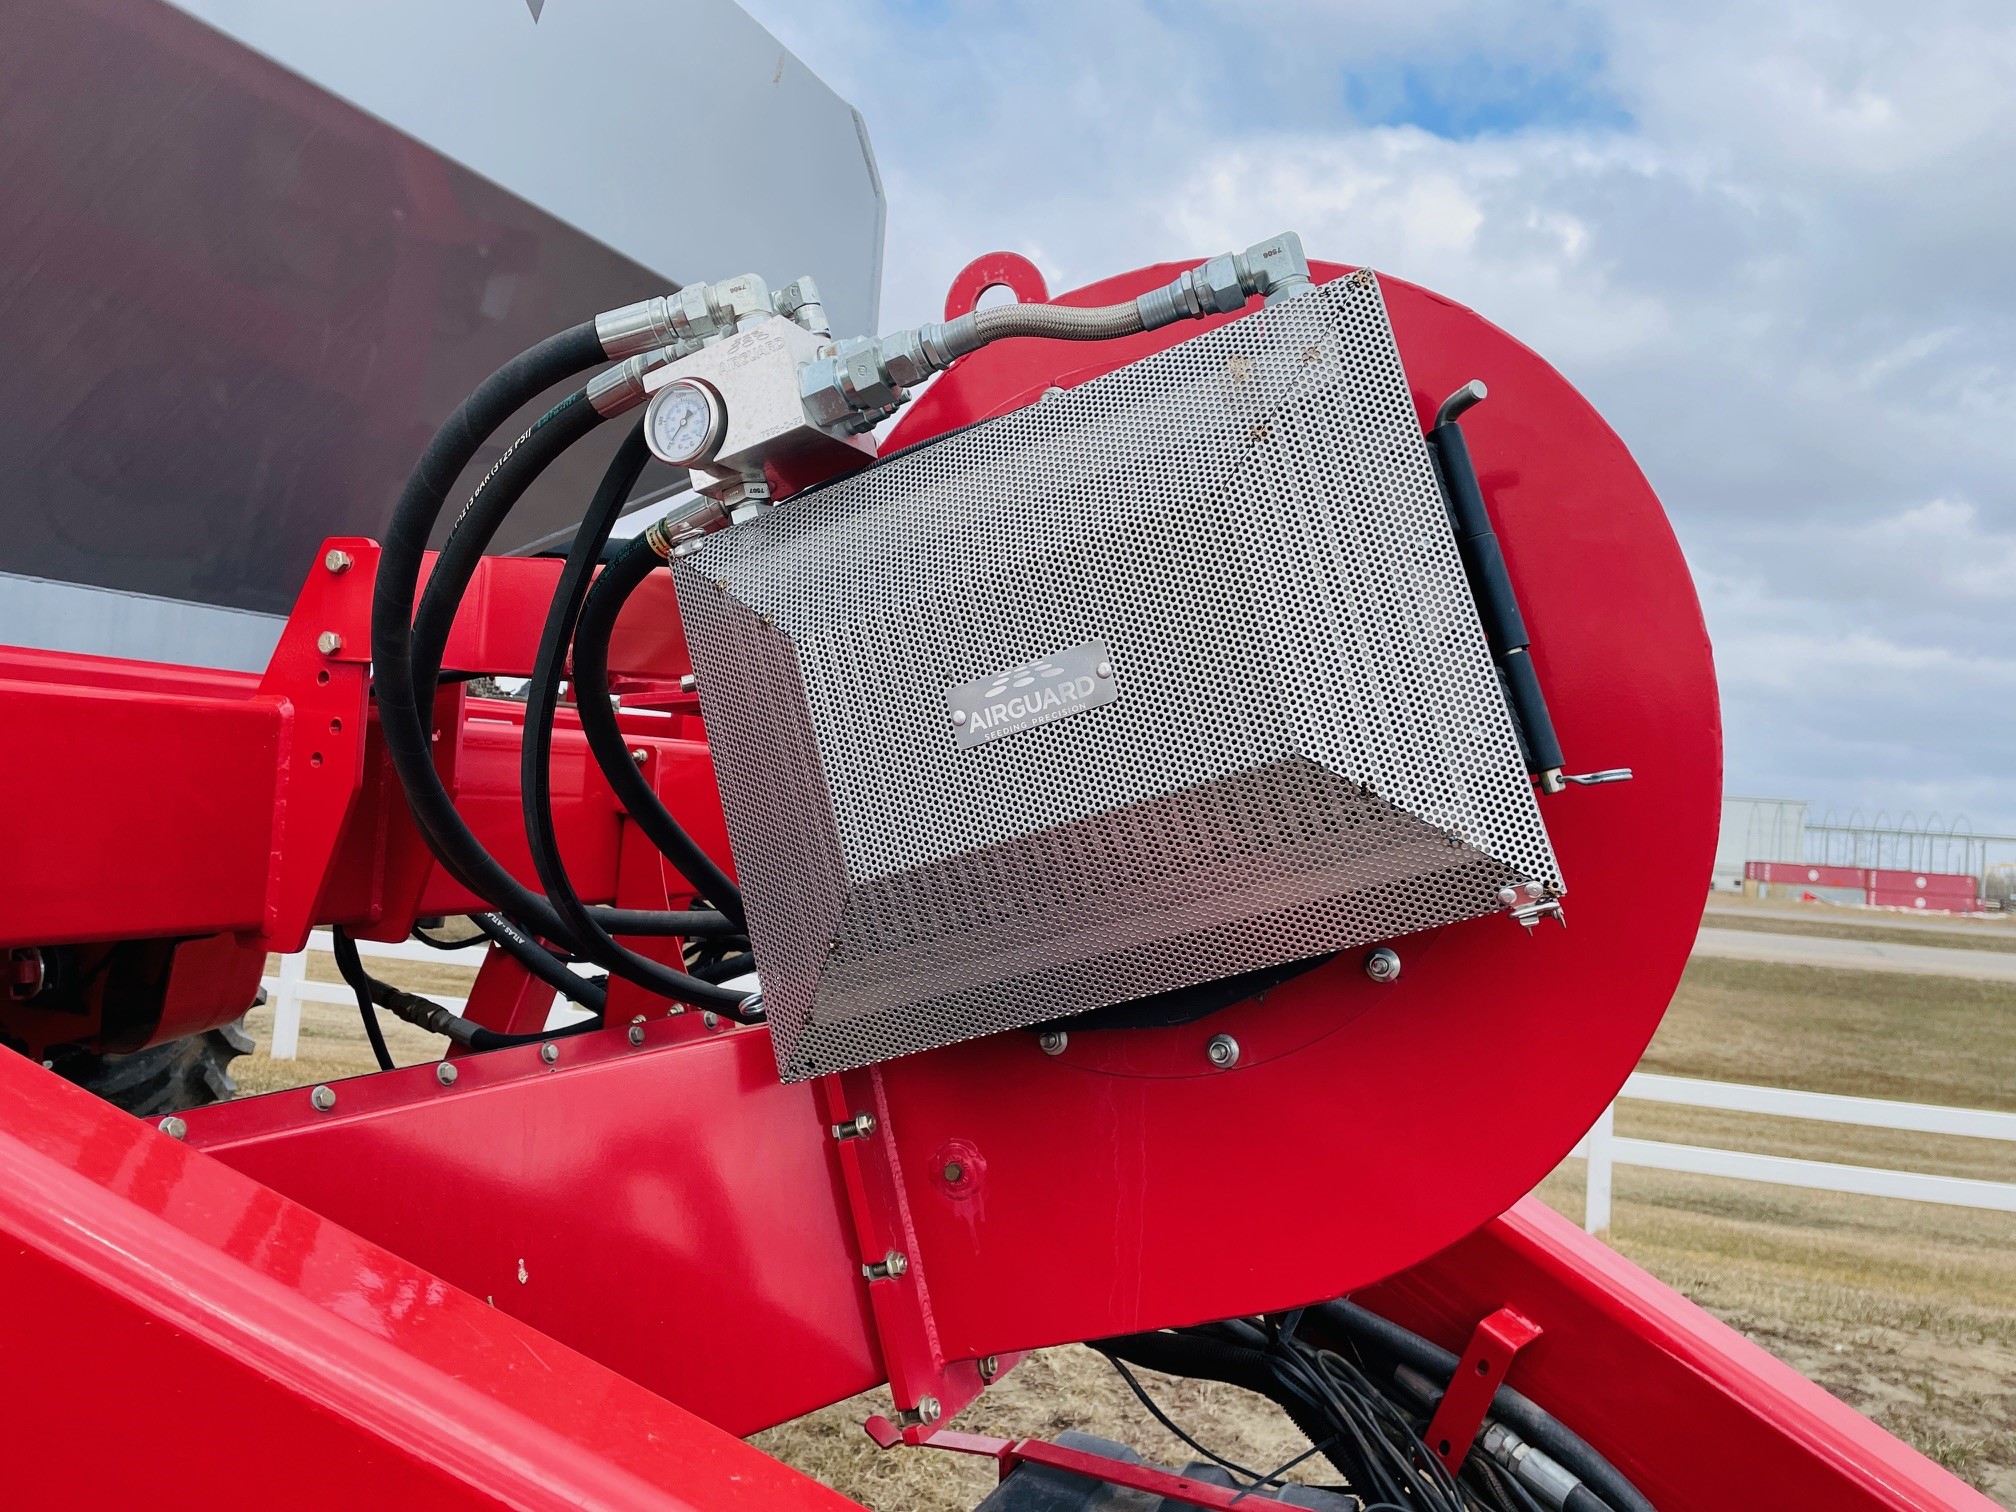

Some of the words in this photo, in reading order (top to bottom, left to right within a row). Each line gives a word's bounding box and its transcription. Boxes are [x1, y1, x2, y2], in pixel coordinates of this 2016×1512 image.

[718, 336, 786, 375] AIRGUARD
[969, 676, 1095, 734] AIRGUARD
[984, 721, 1027, 740] SEEDING
[1032, 702, 1087, 725] PRECISION
